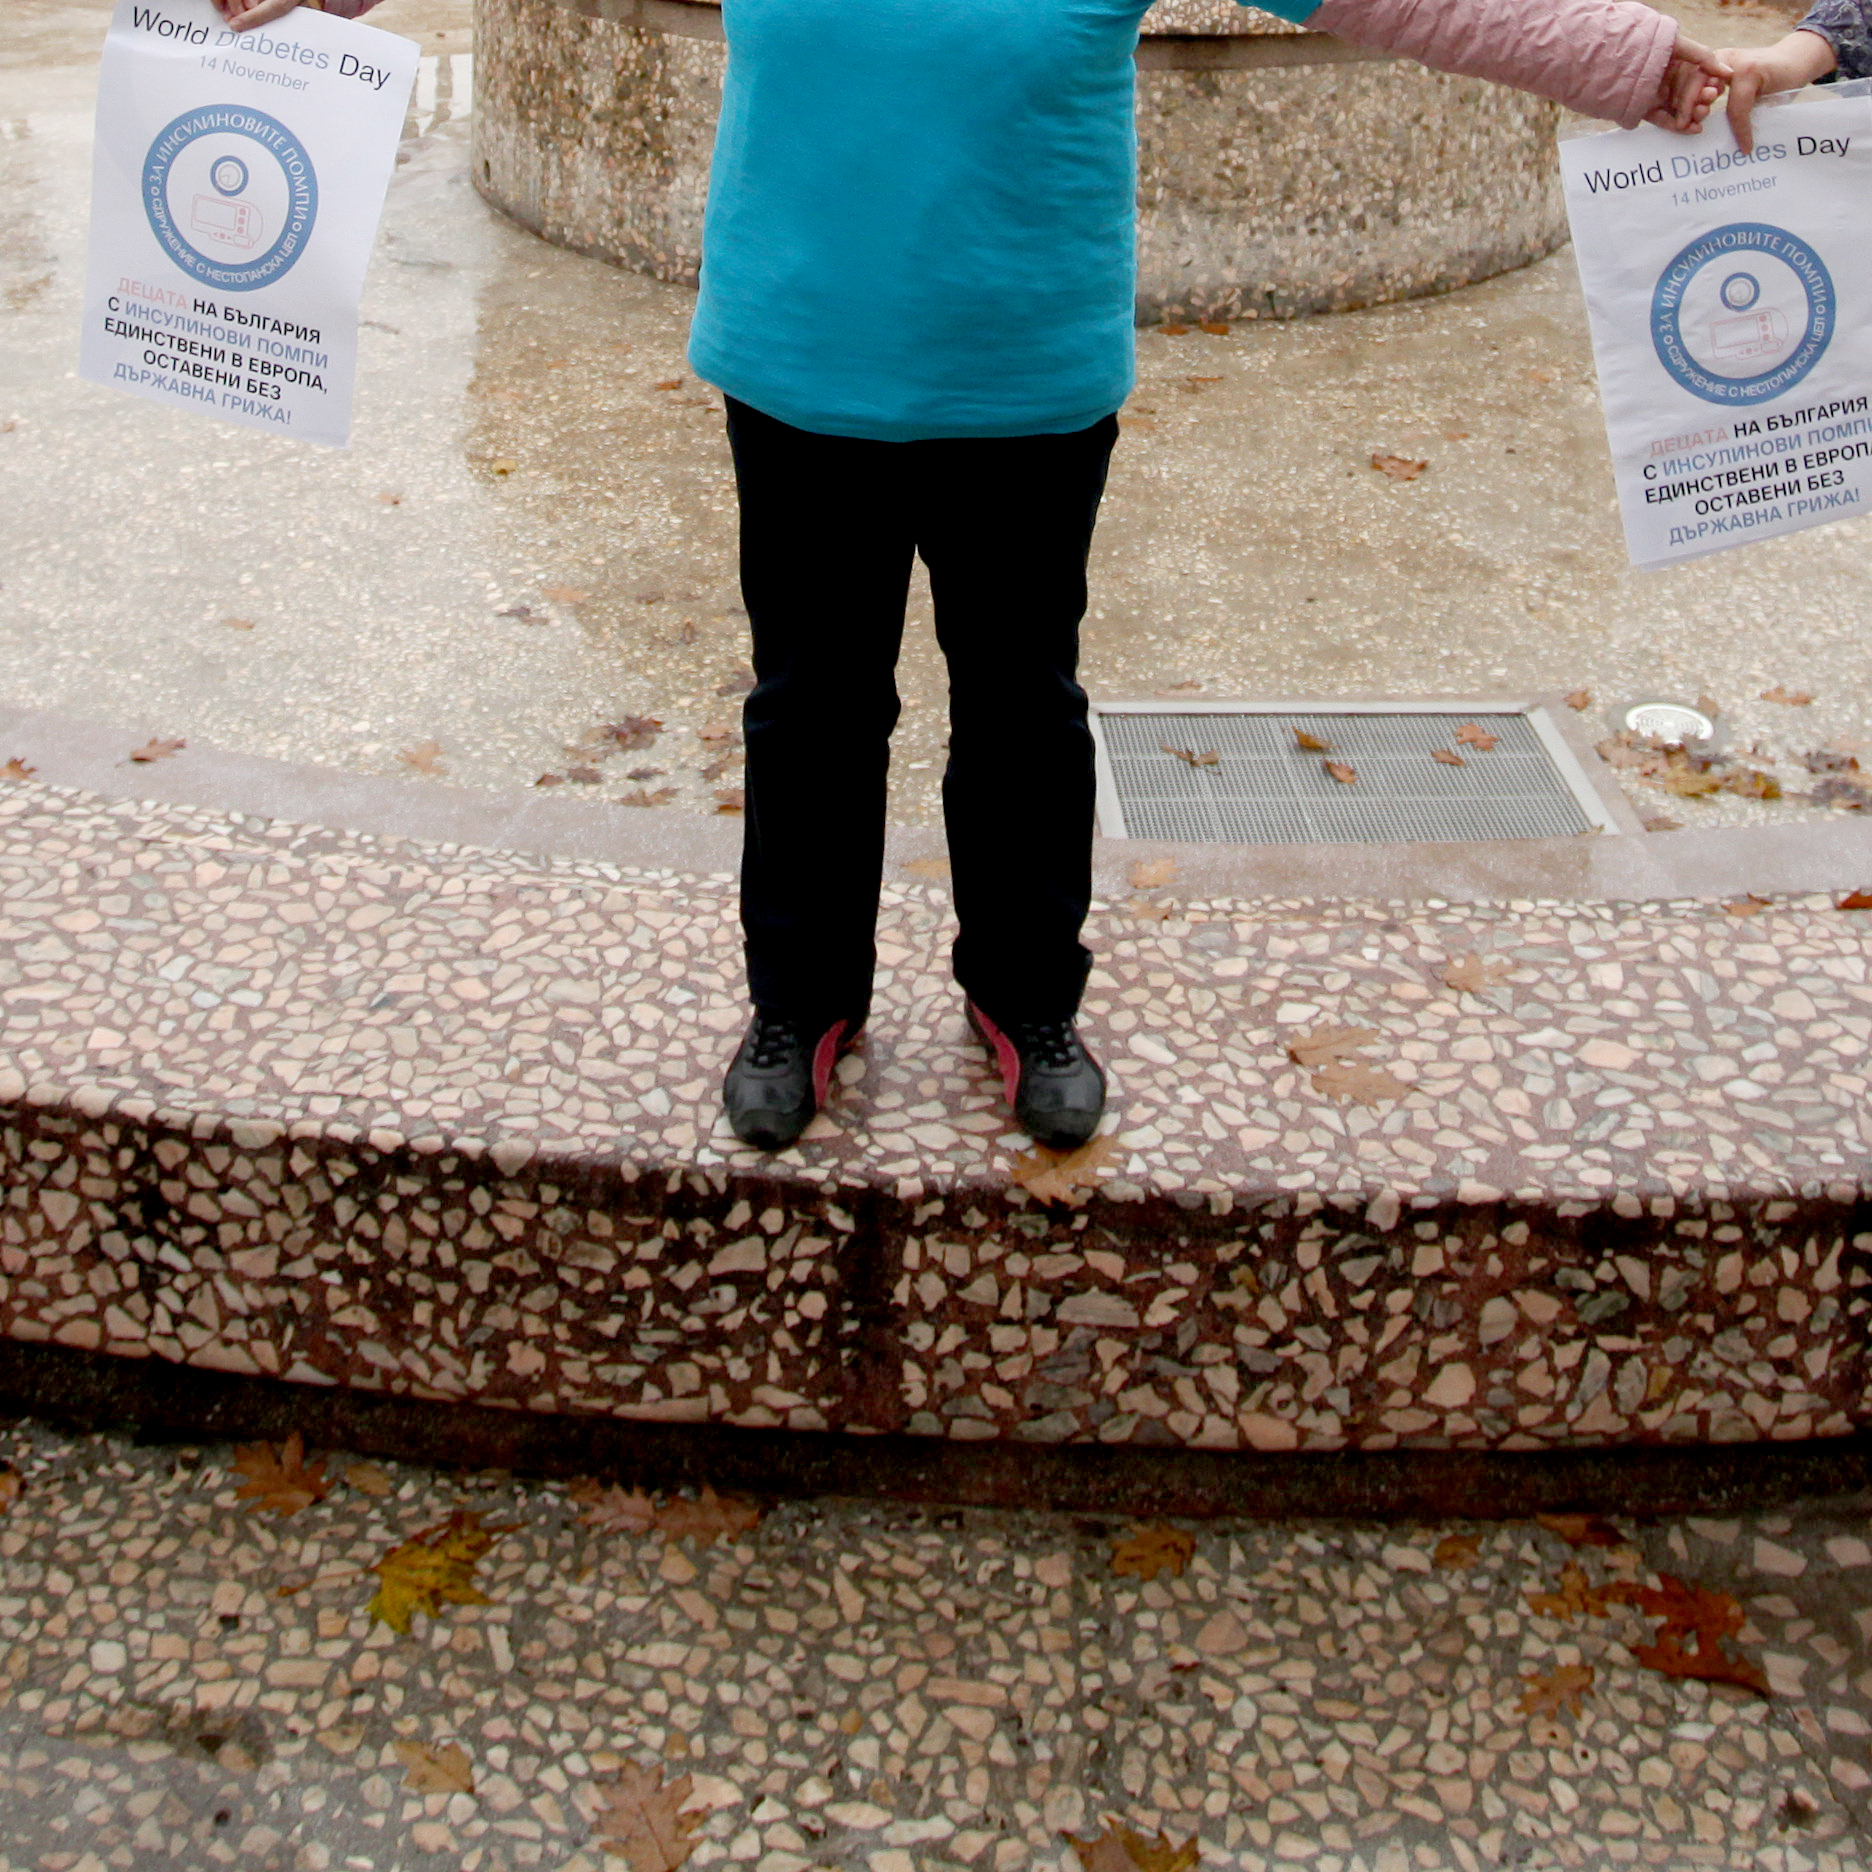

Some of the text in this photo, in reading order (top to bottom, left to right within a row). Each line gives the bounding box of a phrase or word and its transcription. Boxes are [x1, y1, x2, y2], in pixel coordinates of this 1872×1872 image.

[133, 6, 391, 91] World Diabetes Day
[199, 55, 310, 91] 14 November
[149, 113, 310, 220] ЗА ИНСУЛИНОВИТЕ ПОМПИ
[1583, 160, 1664, 194] World
[1796, 136, 1851, 158] Day
[1671, 176, 1778, 207] 14 November
[152, 198, 198, 268] СДРУЖЕНИЕ
[196, 262, 206, 273] С
[206, 255, 285, 283] НЕСТОПАНСКА
[117, 277, 321, 344] ДЕЦАТА НА БЪЛГАРИЯ
[1659, 231, 1827, 334] ЗА ИНСУЛИНОВИТЕ ПОМПИ
[104, 317, 328, 395] ЕДИНСТВЕНИ В ЕВРОПА,
[108, 296, 328, 369] С ИНСУЛИНОВИ ПОМПИ
[113, 362, 292, 425] ДЪРЖАВНА ГРИЖА!
[143, 349, 281, 400] ОСТАВЕНИ БЕЗ
[1667, 345, 1727, 397] СДРУЖЕНИЕ
[1728, 385, 1739, 397] С
[1643, 464, 1657, 480] С
[1663, 434, 1802, 477] ИНСУЛИНОВИ
[1650, 396, 1869, 458] ДЕЦАТА НА БЪЛГАРИЯ
[1645, 463, 1779, 505] ЕДИНСТВЕНИ
[1785, 458, 1798, 474] В
[1695, 469, 1845, 516] ОСТАВЕНИ БЕЗ
[1669, 487, 1861, 547] ДЪРЖАВНА ГРИЖА!
